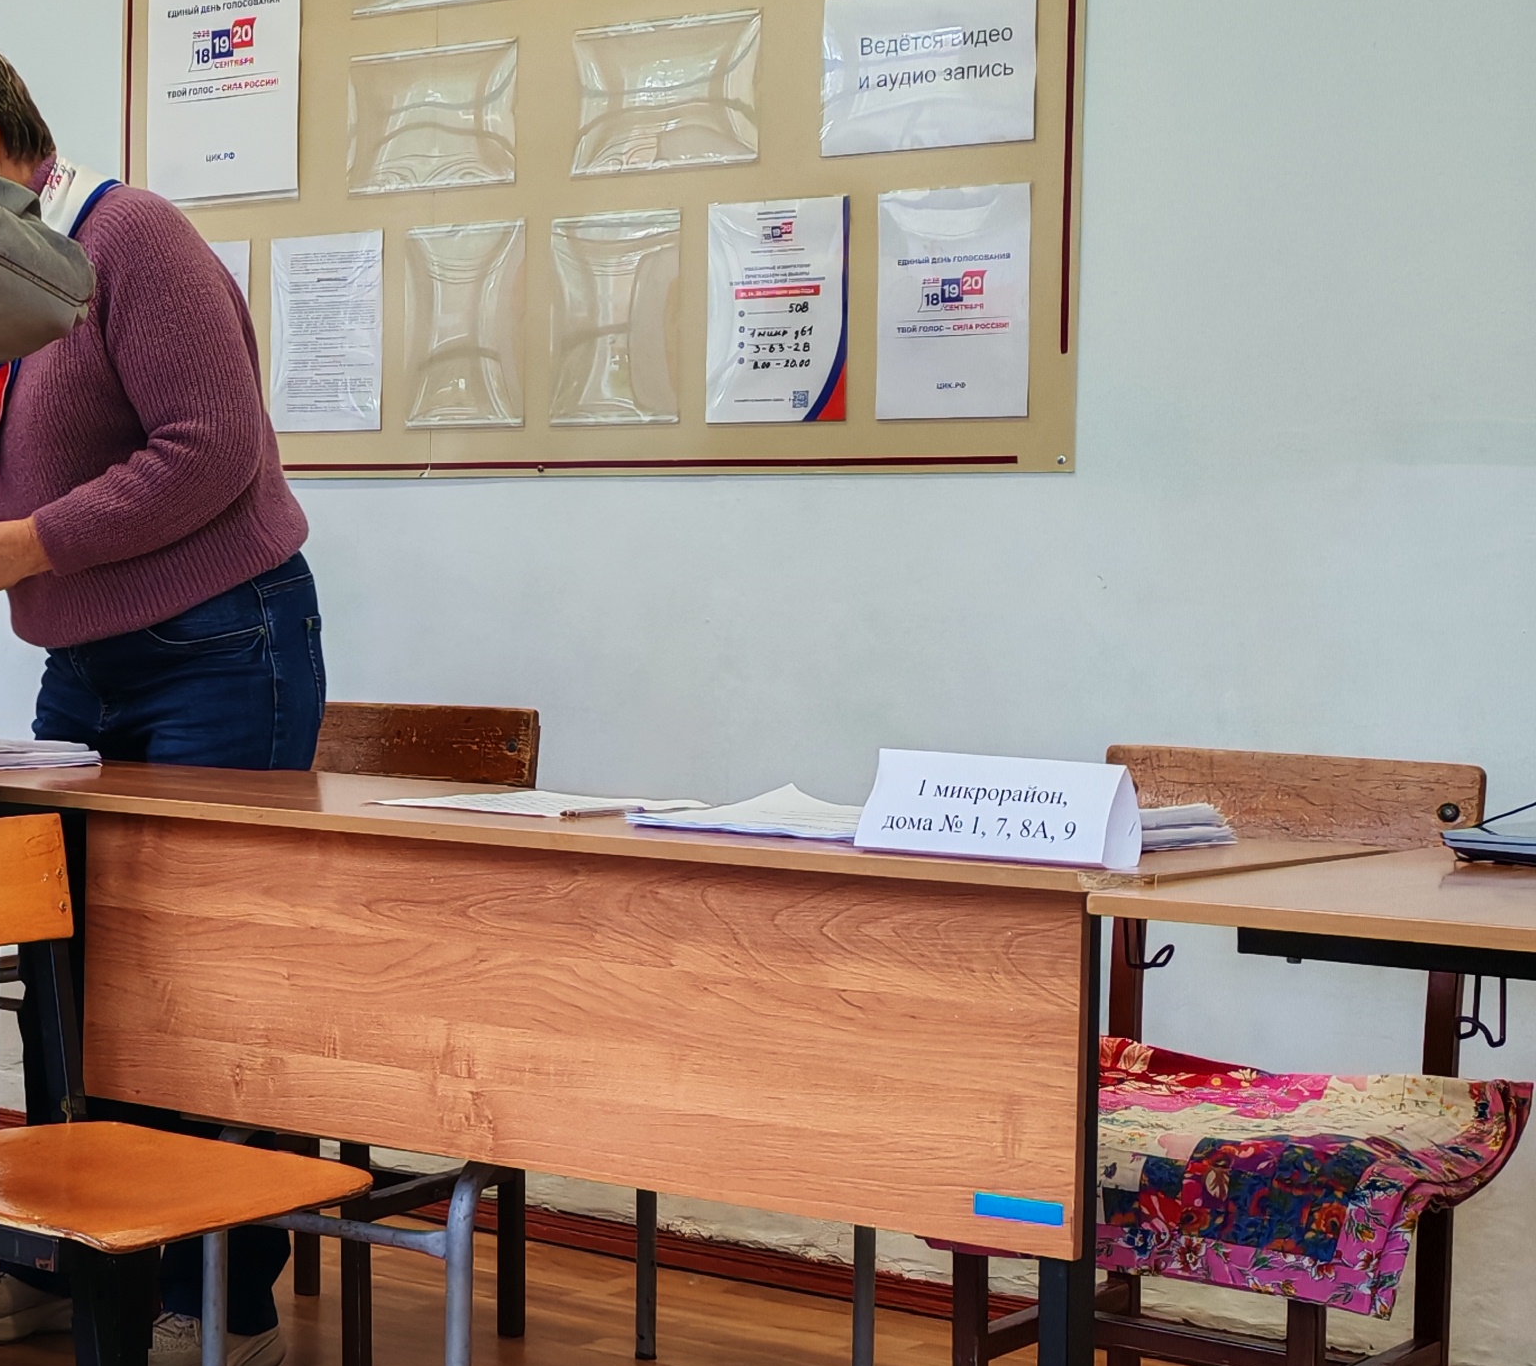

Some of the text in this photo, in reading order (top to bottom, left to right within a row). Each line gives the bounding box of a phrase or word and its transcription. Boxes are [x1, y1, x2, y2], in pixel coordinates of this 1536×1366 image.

[167, 5, 200, 19] ЕДИНЫЙ
[200, 4, 222, 15] ДЕНЬ
[195, 25, 252, 65] 18 19 20
[860, 26, 1013, 56] Ведётся видео
[859, 62, 1014, 92] и аудио запись
[167, 88, 187, 99] ТВОЙ
[188, 86, 214, 96] ГОЛОС
[221, 82, 243, 92] СИЛА
[244, 78, 279, 89] РОССИИ!
[897, 256, 930, 266] ЕДИНЫЙ
[953, 252, 1011, 264] ГОЛОСОВАНИЯ
[943, 284, 959, 298] 19
[962, 276, 982, 291] 20
[924, 293, 940, 306] 18
[952, 323, 974, 331] СИЛА
[918, 779, 1068, 808] 1 микрорайон,
[881, 814, 1077, 844] дома № 1, 7, 8А, 9
